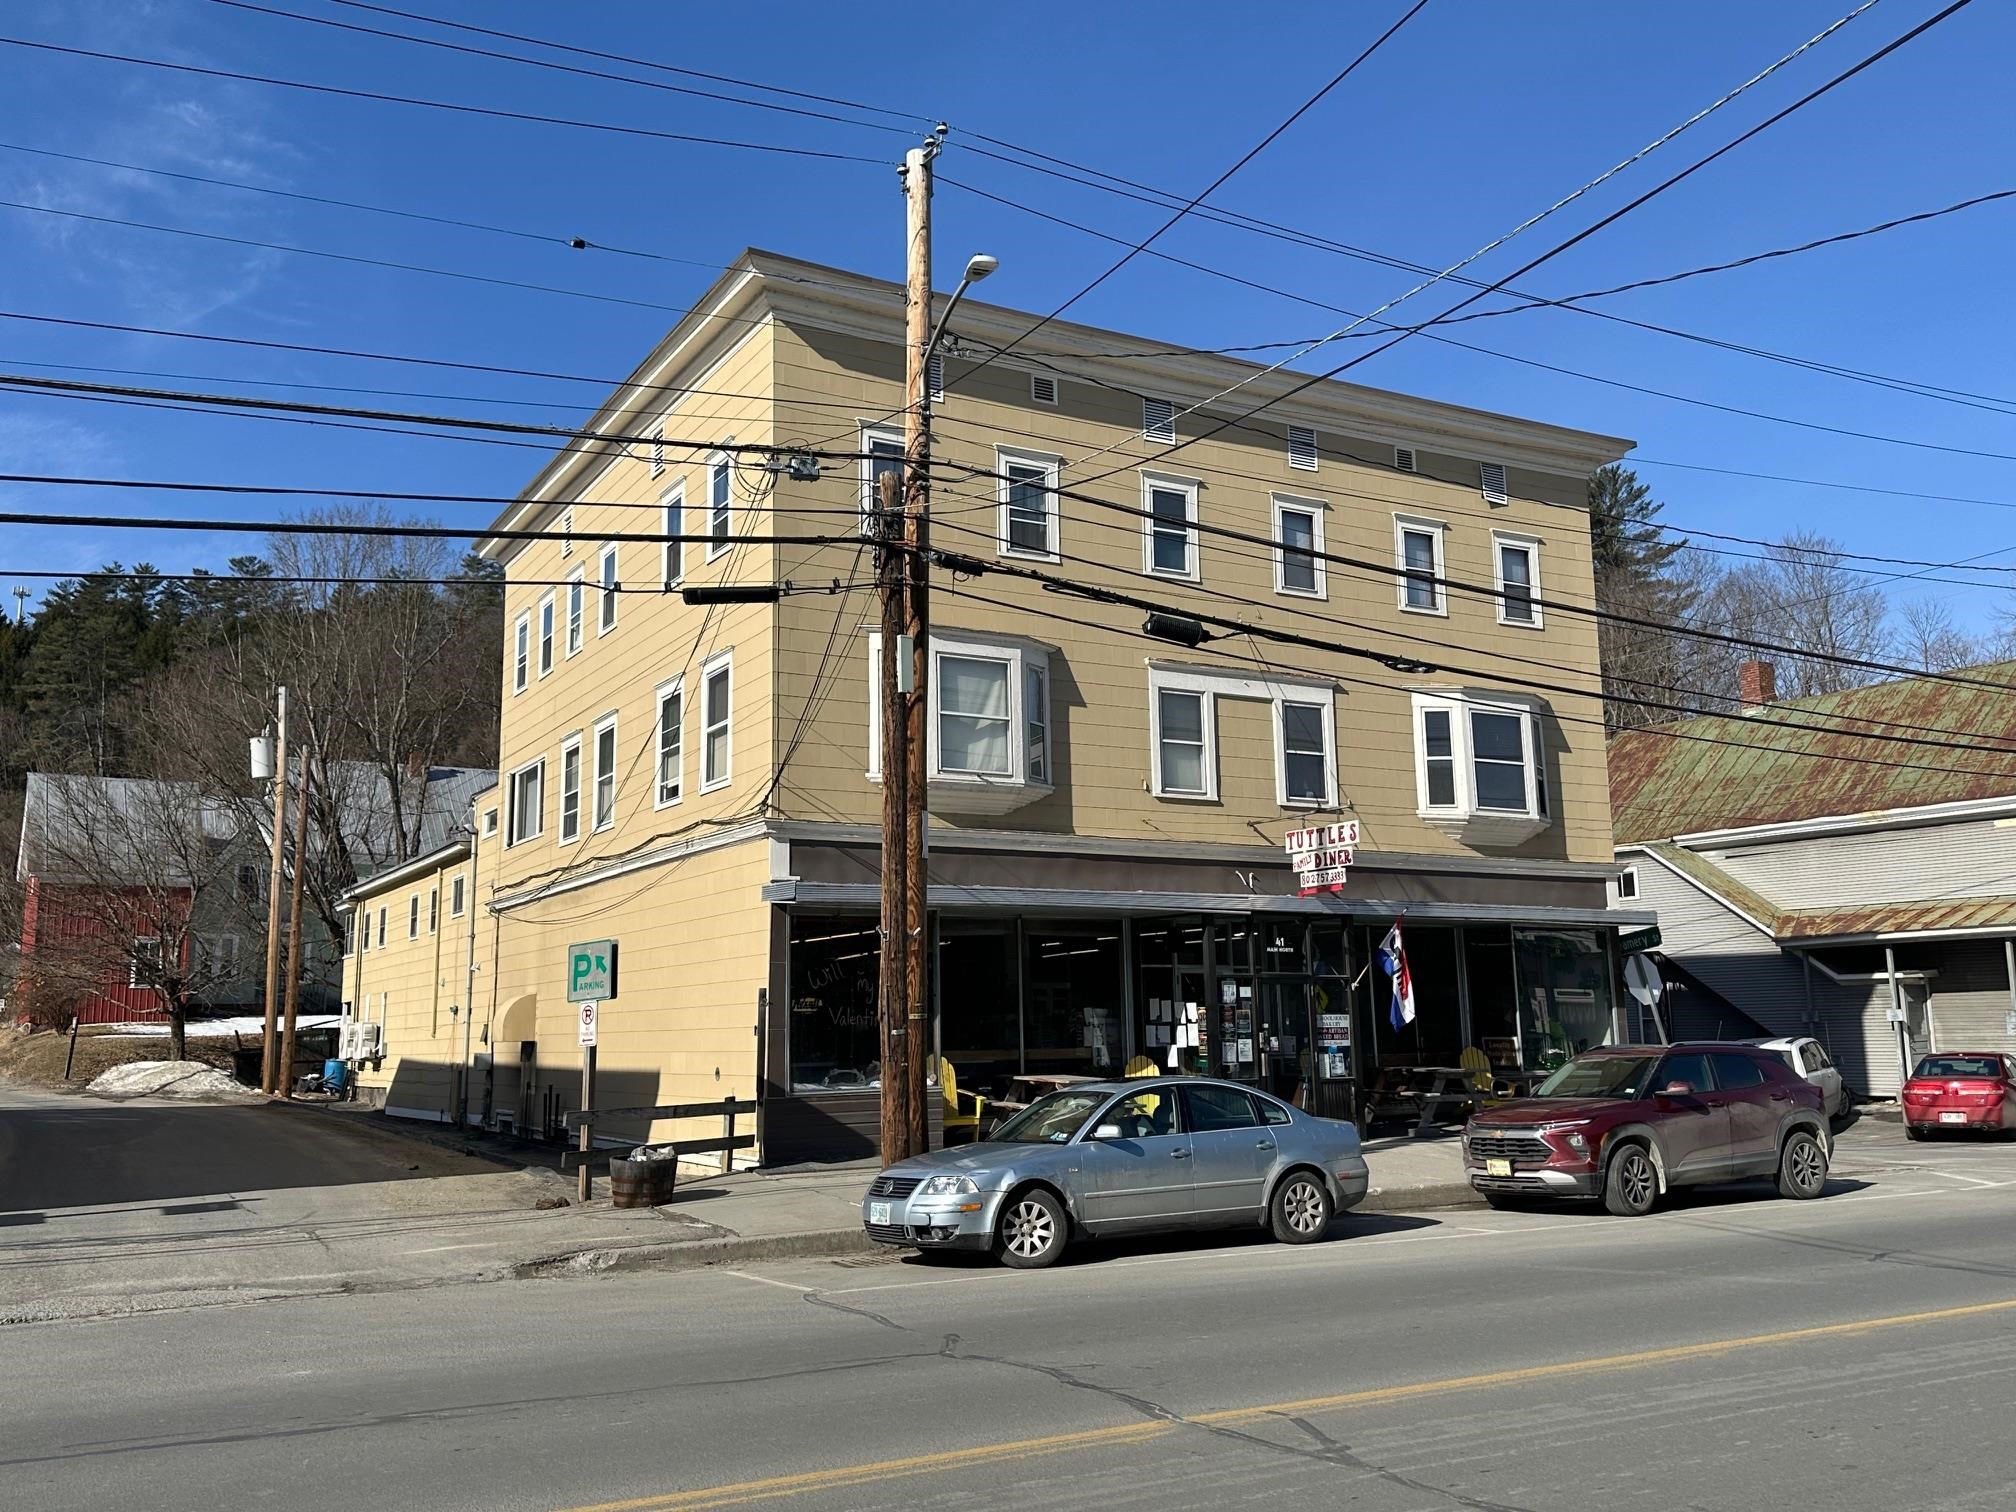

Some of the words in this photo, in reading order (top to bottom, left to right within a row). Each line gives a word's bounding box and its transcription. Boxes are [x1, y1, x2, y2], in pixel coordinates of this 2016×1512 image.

[1286, 823, 1357, 850] TUTTLE'S
[1293, 853, 1312, 871] FAMILY
[1314, 849, 1352, 868] DINER
[1275, 937, 1285, 947] 41
[1622, 935, 1648, 950] omery
[807, 962, 847, 990] Will
